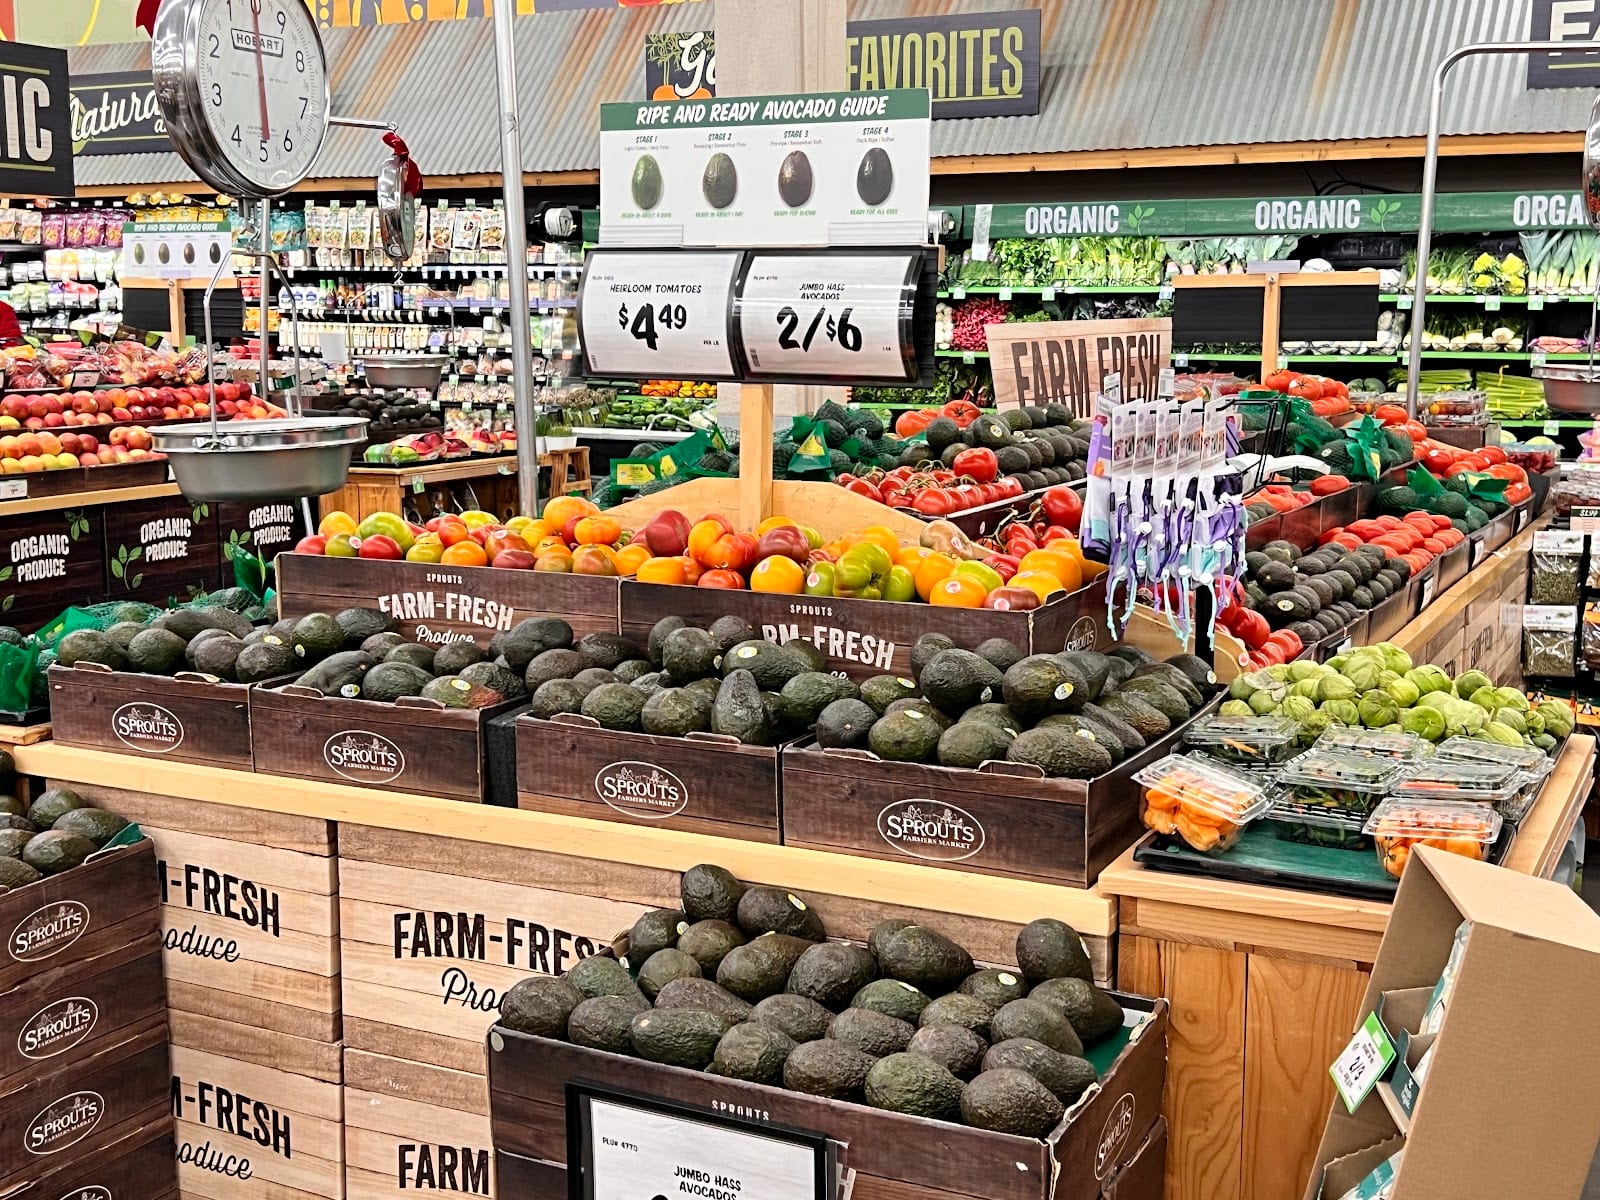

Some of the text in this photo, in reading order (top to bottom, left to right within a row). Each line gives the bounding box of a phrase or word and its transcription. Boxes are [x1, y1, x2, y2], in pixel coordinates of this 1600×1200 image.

[226, 0, 232, 21] 1
[277, 11, 286, 34] 9
[209, 33, 220, 58] 2
[236, 33, 279, 51] HOBART
[296, 51, 305, 73] 8
[846, 26, 1023, 97] FAVORITES
[212, 83, 222, 107] 3
[299, 97, 308, 119] 7
[636, 95, 889, 125] RIPE AND READY AVOCADO GUIDE
[231, 124, 242, 148] 4
[284, 129, 293, 152] 6
[636, 135, 653, 143] STAGE
[708, 133, 726, 141] STAGE
[784, 130, 802, 138] STAGE
[862, 127, 882, 135] STAGE
[260, 140, 268, 162] 5
[1025, 205, 1119, 234] ORGANIC
[1255, 199, 1360, 230] ORGANIC
[1513, 194, 1589, 227] ORGA
[610, 283, 702, 294] HEIRLOOM TOMATOES
[799, 283, 846, 291] JUMBO HASS
[800, 292, 841, 301] AVOCADOS
[776, 305, 863, 352] 2/$6
[1011, 334, 1161, 420] FARM FRESH
[249, 504, 294, 529] ORGANIC
[140, 518, 192, 544] ORGANIC
[253, 526, 291, 546] PRODUCE
[11, 534, 70, 562] ORGANIC
[145, 540, 189, 563] PRODUCE
[17, 558, 66, 583] PRODUCE
[426, 573, 463, 585] SPROUTS
[378, 591, 514, 631] FARM-FRESH
[790, 604, 833, 617] SPROUTS
[118, 716, 177, 736] SPROUTS
[331, 745, 397, 767] SPROUTS
[370, 764, 395, 773] MARKET
[603, 776, 679, 801] SPROUTS
[617, 794, 676, 808] FARMERS MARKET
[886, 815, 975, 842] SPROUTS
[902, 834, 972, 850] FARMERS MARKET
[15, 912, 82, 954] SPROUTS
[29, 926, 80, 951] FARMERS MARKET
[160, 925, 241, 962] oduce
[394, 911, 608, 976] FARM-FRES
[25, 1008, 91, 1052] SPROUTS
[37, 1023, 89, 1049] FARMERS MARKET
[711, 1100, 769, 1121] SPROUTS
[31, 1101, 98, 1148] SPROUTS
[71, 1117, 95, 1131] MARKET
[621, 1141, 638, 1152] 4770
[174, 1141, 253, 1180] oduce
[399, 1144, 489, 1196] FARM
[674, 1165, 742, 1192] JUMBO HASS
[679, 1181, 737, 1200] AVOCADOS
